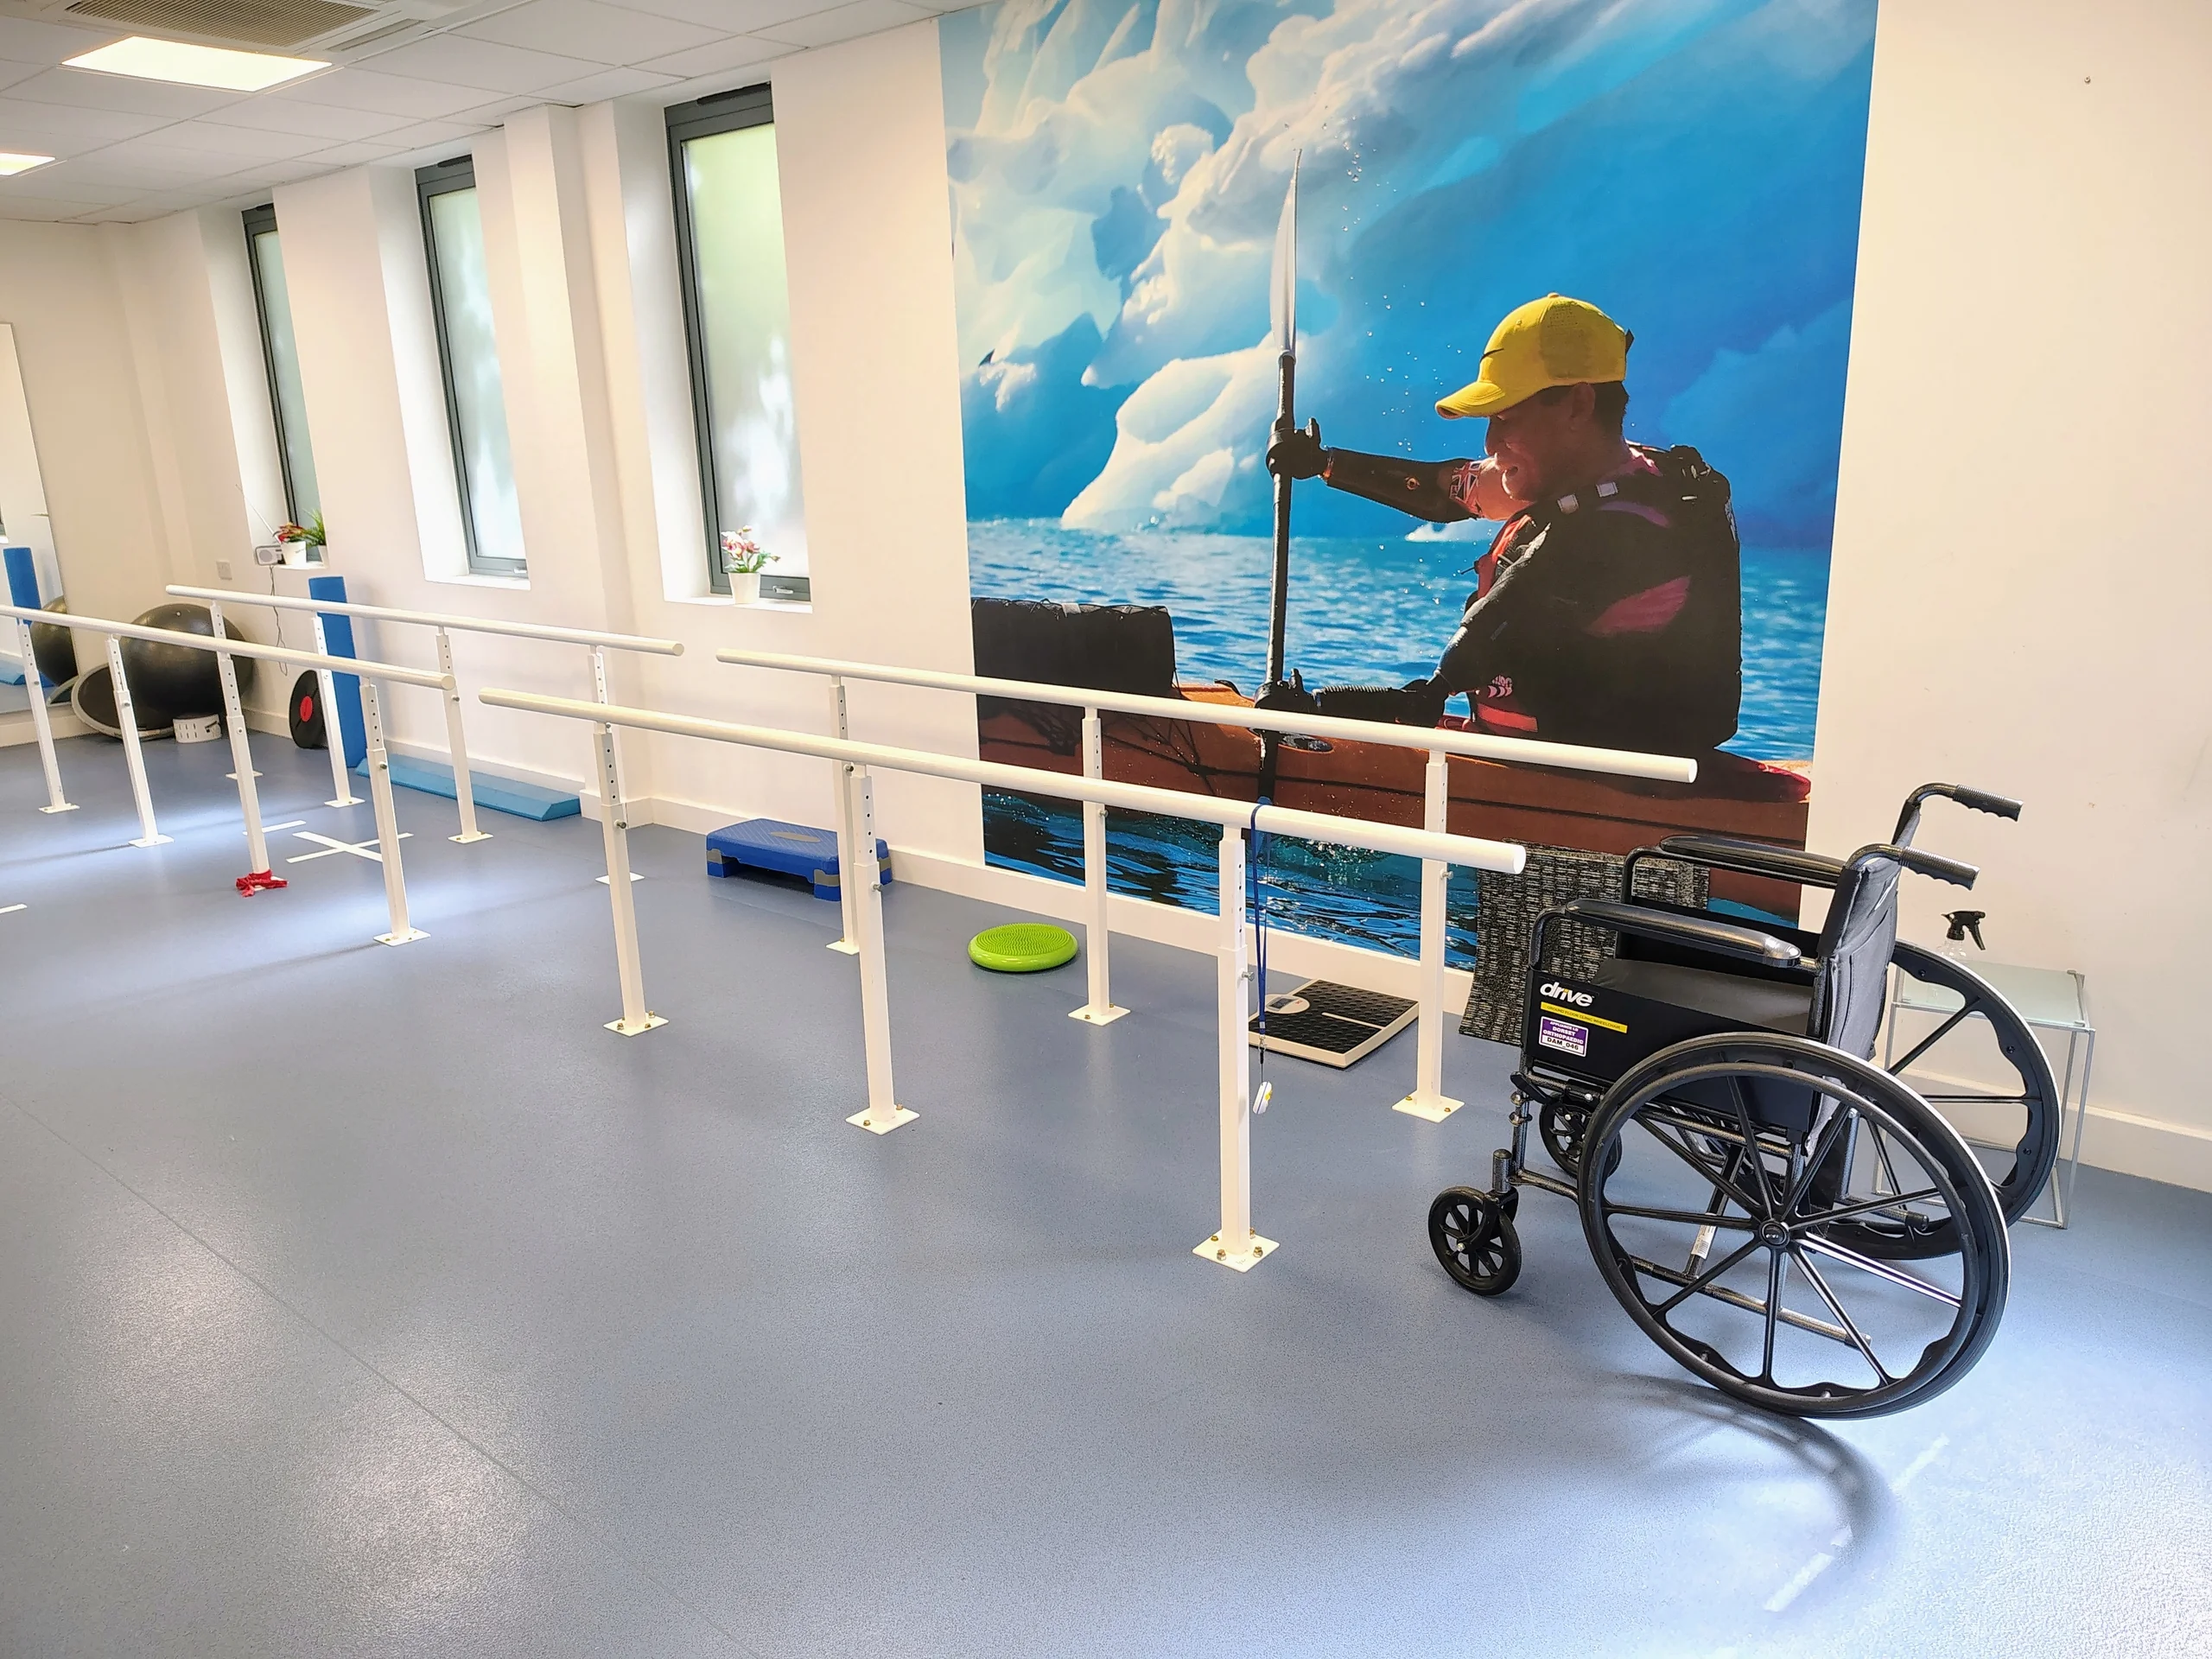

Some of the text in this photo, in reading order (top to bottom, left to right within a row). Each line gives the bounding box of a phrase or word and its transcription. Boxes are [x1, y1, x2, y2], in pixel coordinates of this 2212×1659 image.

[1540, 982, 1593, 1007] drive
[1547, 1005, 1564, 1014] GROUND
[1593, 1018, 1621, 1030] WHEELCHAIR
[1549, 1021, 1572, 1030] APPLIANCE
[1543, 1029, 1584, 1045] ORTHOPAEDIC
[1552, 1027, 1576, 1036] DORSET
